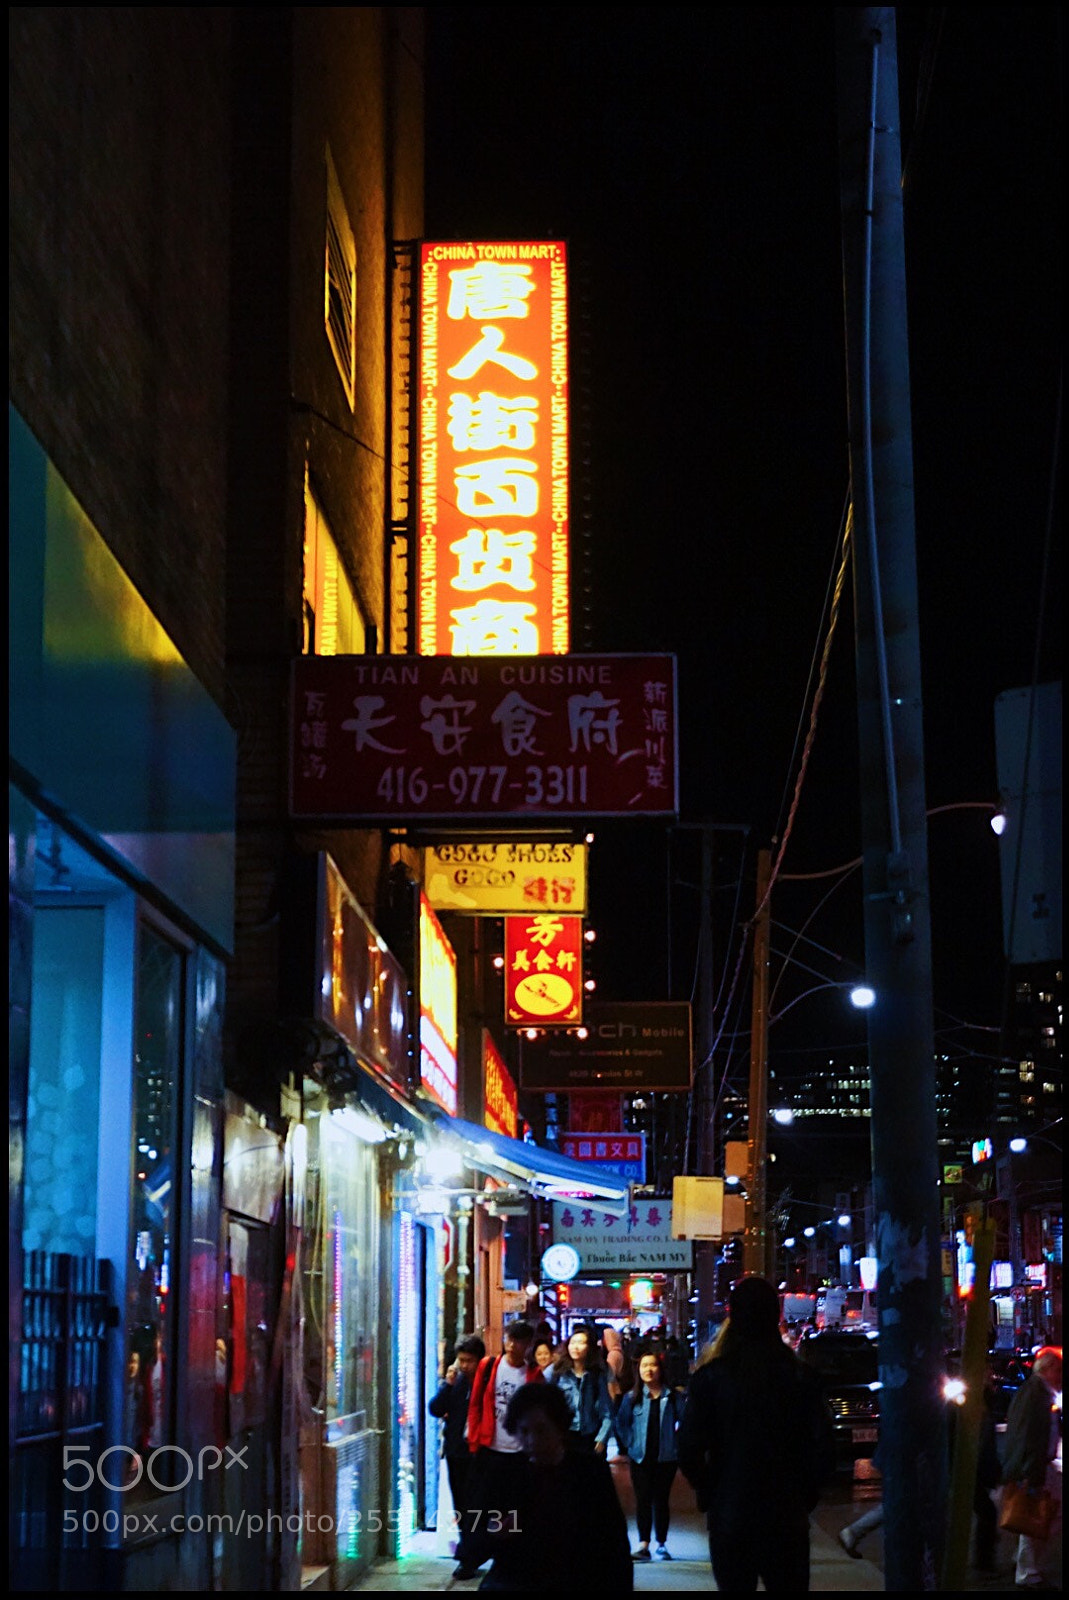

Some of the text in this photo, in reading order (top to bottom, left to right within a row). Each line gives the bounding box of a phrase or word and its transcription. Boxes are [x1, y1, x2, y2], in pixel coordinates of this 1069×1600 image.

[433, 245, 556, 260] CHINA TOWN MART
[422, 262, 438, 387] CHINA TOWN MART
[551, 261, 567, 384] CHINA TOWN MART
[421, 398, 437, 525] CHINA TOWN MART
[551, 396, 568, 522] CHINA TOWN MART
[421, 535, 437, 579] CHINA
[421, 579, 437, 622] TOWN
[552, 532, 568, 655] HINA TOWN MART
[355, 665, 613, 685] TIAN AN CUISINE
[341, 690, 624, 758] 天安食府
[377, 765, 588, 804] 416-977-3311
[435, 844, 575, 863] GOGO SHOES
[454, 868, 516, 885] GOGO
[602, 1235, 644, 1244] TRADING
[640, 1253, 666, 1262] NAM
[669, 1253, 687, 1262] MY
